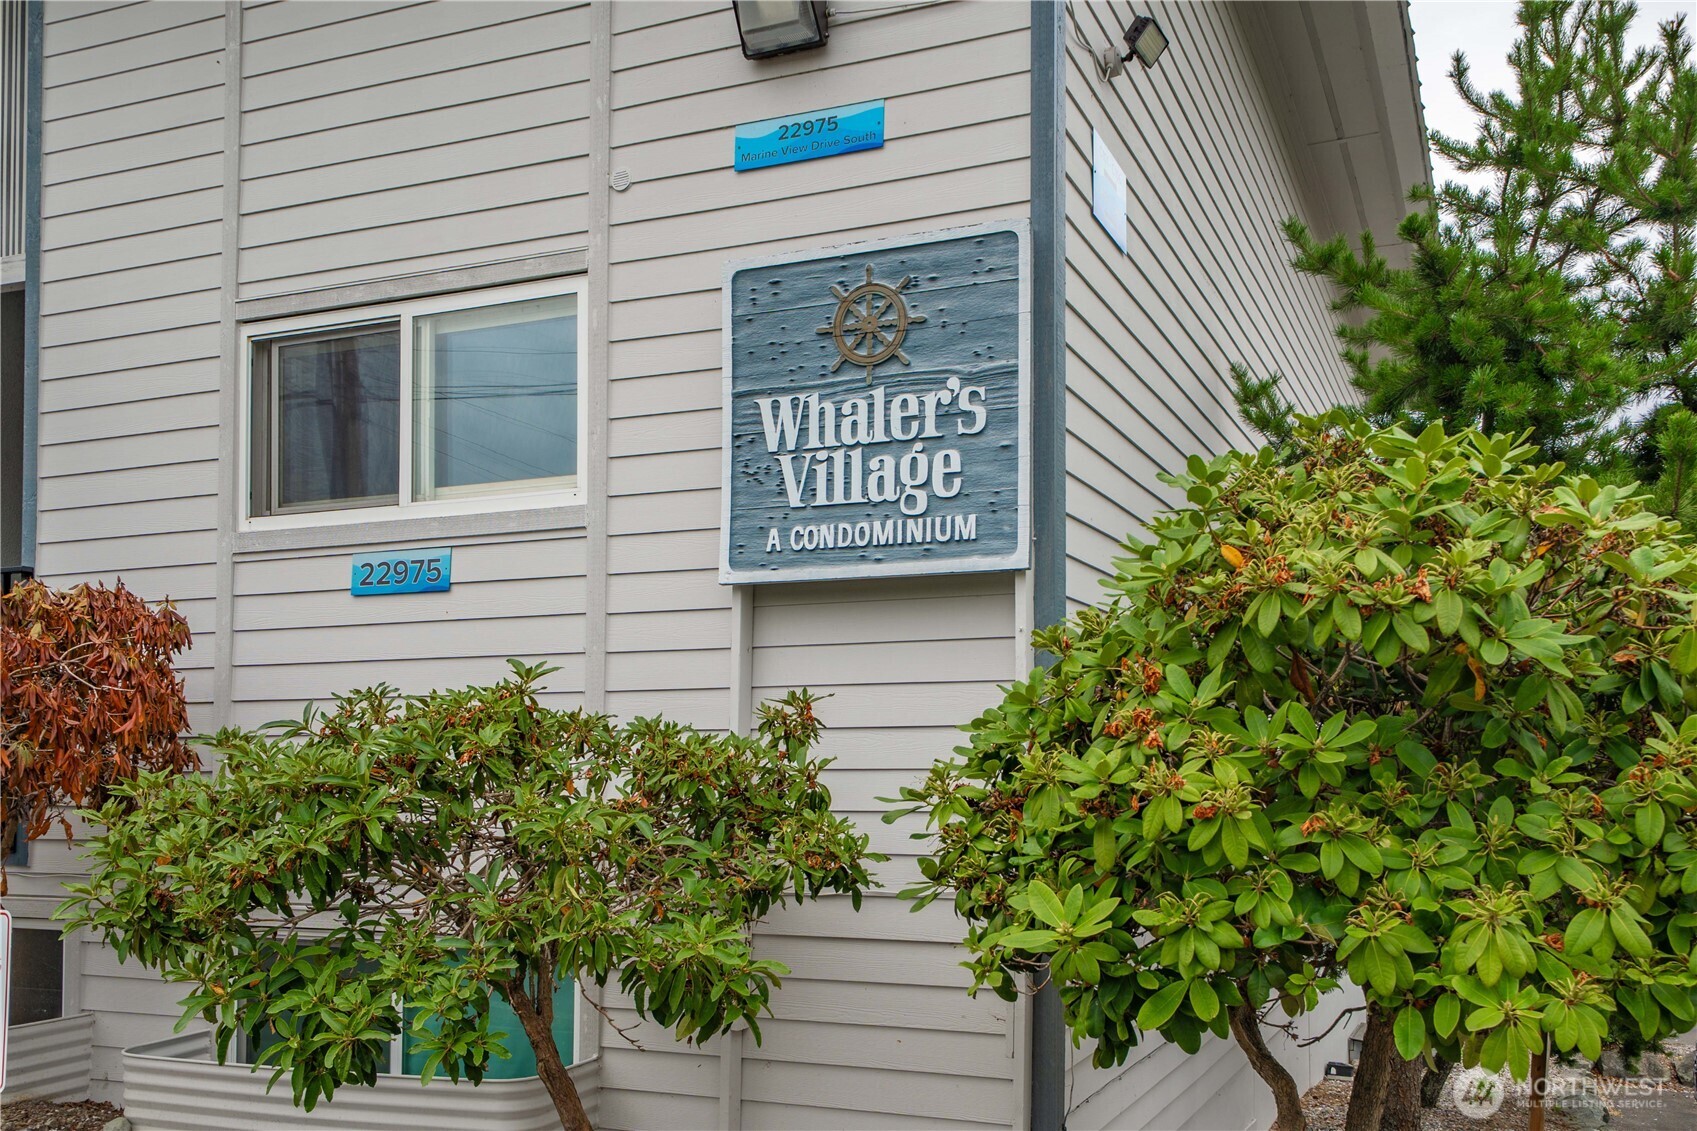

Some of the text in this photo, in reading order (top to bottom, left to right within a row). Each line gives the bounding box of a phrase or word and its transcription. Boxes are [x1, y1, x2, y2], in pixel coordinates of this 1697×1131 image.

[778, 115, 838, 141] 22975
[741, 132, 877, 162] Marine View Drive South
[754, 376, 987, 453] Whaler's
[774, 442, 962, 516] Village
[766, 514, 977, 552] A CONDOMINIUM
[359, 558, 442, 588] 22975
